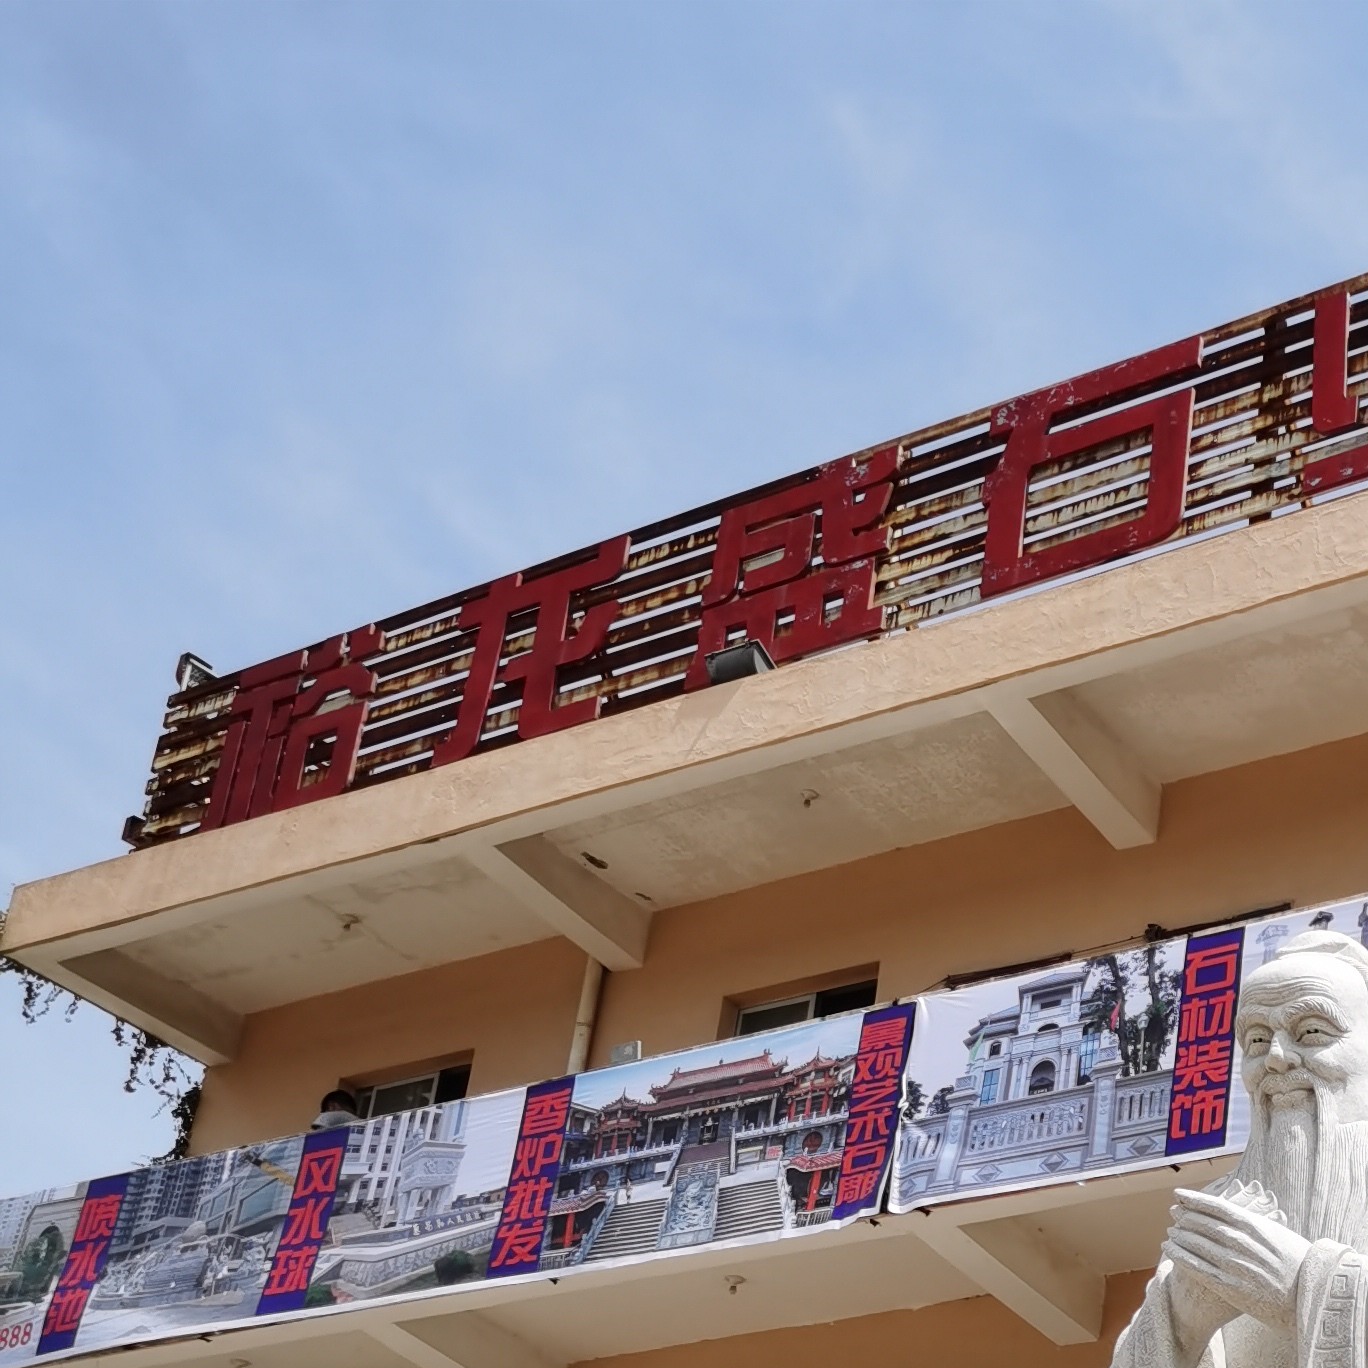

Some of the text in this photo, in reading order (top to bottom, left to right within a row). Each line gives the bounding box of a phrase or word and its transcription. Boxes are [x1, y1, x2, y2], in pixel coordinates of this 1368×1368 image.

[835, 1016, 907, 1206] 景观艺术石雕
[1171, 943, 1239, 1139] 石材装饰
[44, 1194, 123, 1336] 喷水池
[264, 1147, 342, 1296] 风水球
[491, 1088, 571, 1267] 香炉批发
